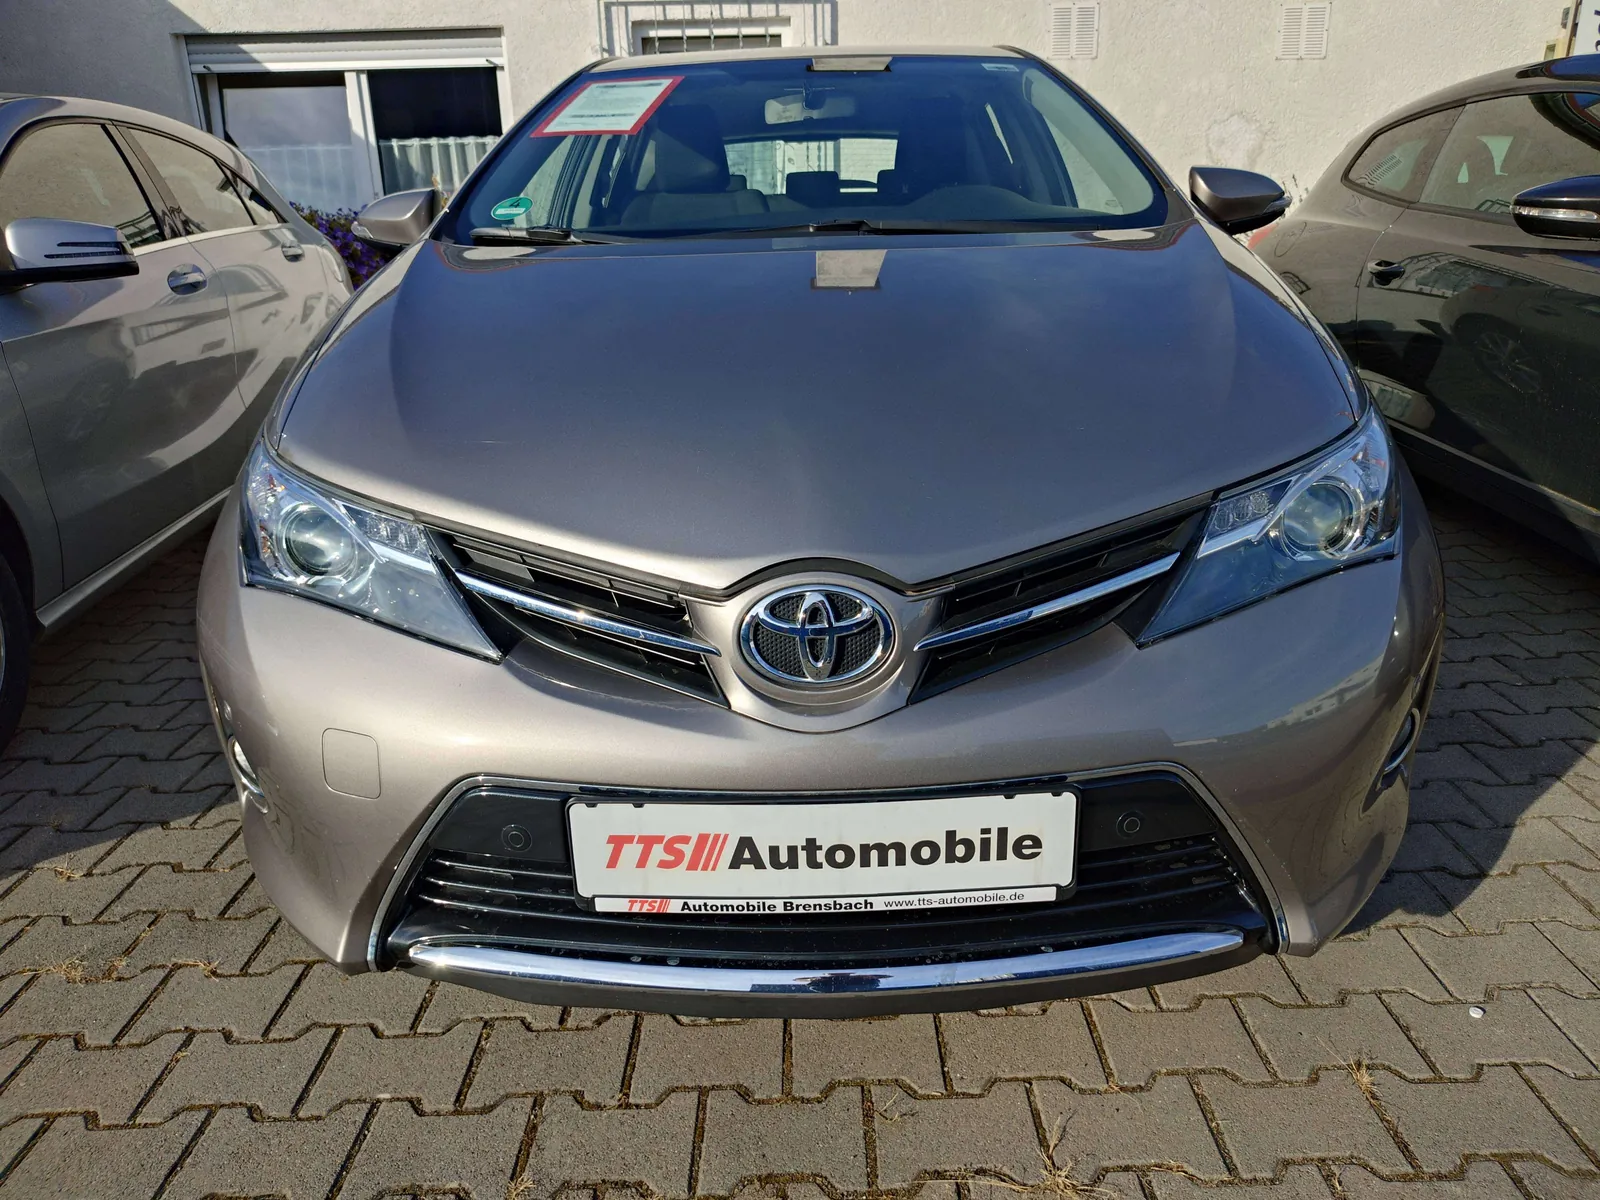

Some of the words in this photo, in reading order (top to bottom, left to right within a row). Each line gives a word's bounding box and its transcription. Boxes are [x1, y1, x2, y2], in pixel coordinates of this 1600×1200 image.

[509, 198, 520, 208] 4
[605, 833, 692, 870] TTS
[728, 826, 1043, 871] Automobile
[627, 899, 659, 912] TTS
[680, 900, 777, 912] Automobile
[783, 899, 874, 912] Brensbach
[884, 892, 1025, 908] www.tts-automobile.de
